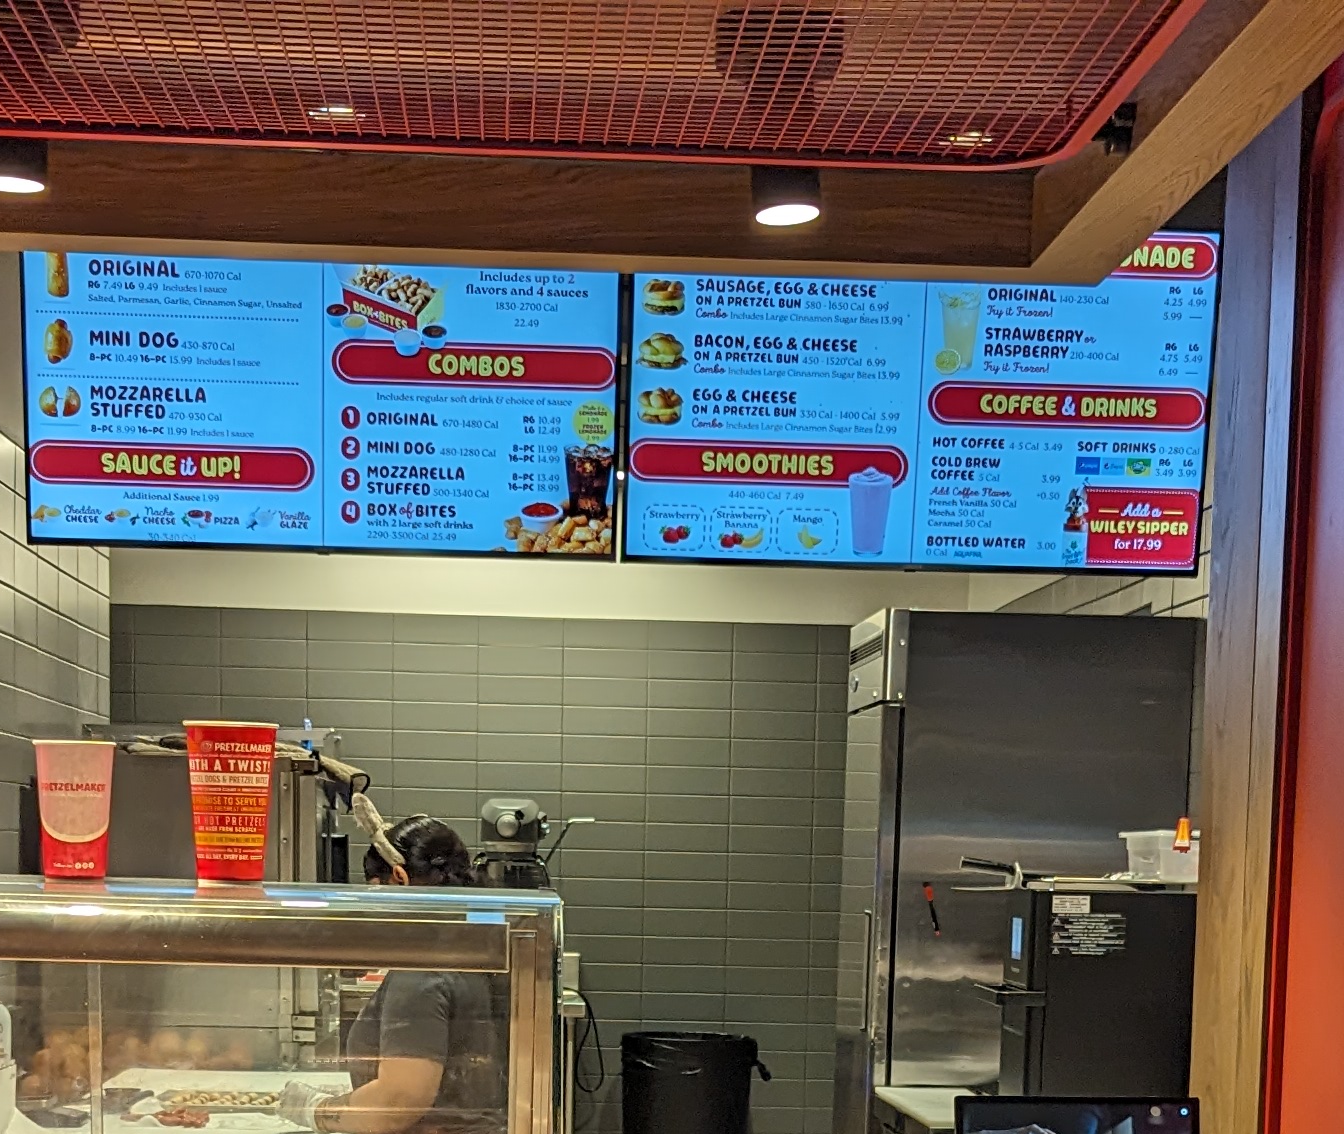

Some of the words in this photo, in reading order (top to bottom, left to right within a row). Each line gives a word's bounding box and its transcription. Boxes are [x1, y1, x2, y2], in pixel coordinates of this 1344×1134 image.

[1120, 245, 1196, 270] NADE
[88, 259, 180, 278] ORIGINAL
[185, 271, 225, 280] 670-1070
[226, 272, 241, 281] Cal
[480, 271, 531, 284] Includes
[534, 273, 549, 286] up
[552, 274, 565, 284] to
[567, 275, 575, 284] 2
[88, 281, 100, 289] RG
[103, 281, 123, 290] 7.49
[125, 282, 136, 290] LG
[138, 282, 158, 291] 9.49
[466, 284, 507, 296] flavors
[510, 285, 533, 297] and
[537, 287, 544, 297] 4
[547, 288, 588, 298] sauces
[696, 279, 771, 296] SAUSAGE,
[774, 281, 804, 294] EGG
[807, 283, 819, 294] &
[821, 283, 877, 298] CHEESE
[1169, 287, 1181, 295] RG
[1193, 288, 1203, 296] LG
[988, 288, 1056, 302] ORIGINAL
[696, 295, 712, 305] ON
[716, 296, 725, 306] A
[727, 297, 775, 308] PRETZEL
[779, 298, 801, 308] BUN
[869, 303, 889, 311] 6.99
[1164, 298, 1183, 307] 4.25
[1187, 298, 1206, 307] 4.99
[352, 301, 374, 317] BOX
[378, 310, 408, 330] BITES
[1163, 312, 1182, 321] 5.99
[514, 319, 539, 328] 22.49
[89, 330, 130, 347] MINI
[139, 332, 179, 348] DOG
[985, 327, 1084, 343] STRAWBERRY
[694, 334, 749, 350] BACON,
[754, 336, 783, 350] EGG
[787, 338, 797, 350] &
[803, 338, 858, 353] CHEESE
[1165, 343, 1177, 351] RG
[1189, 344, 1199, 352] LG
[984, 344, 1069, 359] RASPBERRY
[89, 353, 112, 362] 8-PC
[115, 354, 138, 363] 10.49
[140, 354, 166, 363] 16-PC
[169, 356, 192, 365] 15.99
[1160, 354, 1178, 363] 4.75
[1184, 354, 1203, 363] 5.49
[428, 354, 525, 377] COMBOS
[1159, 368, 1178, 377] 6.49
[90, 385, 207, 403] MOZZARELLA
[693, 389, 722, 401] EGG
[726, 390, 737, 402] &
[742, 390, 797, 404] CHEESE
[91, 402, 165, 420] STUFFED
[980, 394, 1057, 416] COFFEE
[1061, 396, 1076, 416] &
[1080, 397, 1156, 418] DRINKS
[367, 412, 438, 427] ORIGINAL
[523, 416, 535, 425] RG
[538, 416, 561, 425] 10.49
[91, 425, 113, 433] 8-PC
[116, 425, 135, 434] 8.99
[138, 426, 164, 434] 16-PC
[167, 427, 187, 435] 11.99
[525, 426, 535, 434] LG
[538, 426, 561, 435] 12.49
[367, 440, 400, 454] MINI
[404, 442, 435, 455] DOG
[932, 437, 957, 448] HOT
[961, 438, 1005, 449] COFFEE
[1044, 442, 1063, 451] 3.49
[1078, 441, 1108, 453] SOFT
[1112, 442, 1156, 454] DRINKS
[101, 452, 176, 476] SAUCE
[180, 457, 197, 476] it
[201, 455, 241, 479] UP!
[702, 452, 834, 476] SMOOTHIES
[932, 457, 962, 467] COLD
[965, 457, 1000, 468] BREW
[1159, 459, 1171, 467] RG
[1183, 459, 1193, 468] LG
[367, 466, 464, 481] MOZZARELLA
[931, 470, 974, 481] COFFEE
[1155, 469, 1173, 478] 3.49
[1178, 469, 1196, 478] 3.99
[1041, 475, 1061, 484] 3.99
[367, 482, 430, 496] STUFFED
[123, 491, 171, 502] Additional
[173, 492, 200, 502] Sauce
[202, 493, 219, 502] 1.99
[786, 492, 804, 500] 7.49
[64, 504, 102, 515] Cheddar
[145, 506, 175, 516] Nacho
[367, 503, 396, 516] BOX
[399, 501, 415, 517] of
[416, 505, 456, 518] BITES
[1121, 502, 1150, 517] Add
[1152, 508, 1162, 517] a
[65, 514, 99, 524] CHEESE
[143, 516, 176, 525] CHEESE
[214, 516, 240, 525] PIZZA
[279, 510, 311, 521] Vanilla
[649, 510, 700, 521] Strawberry
[716, 511, 767, 522] Strawberry
[793, 515, 822, 525] Mango
[280, 520, 308, 529] GLAZE
[724, 520, 758, 529] Banana
[1090, 520, 1136, 534] WILEY
[1137, 521, 1188, 536] SIPPER
[433, 532, 456, 541] 25.49
[927, 536, 979, 548] BOTTLED
[983, 537, 1026, 549] WATER
[1037, 542, 1056, 550] 3.00
[1114, 538, 1130, 550] for
[1133, 538, 1162, 550] 17.99
[214, 759, 222, 771] A
[228, 760, 271, 773] TWIST!
[224, 797, 233, 805] TO
[235, 797, 257, 806] SERVE
